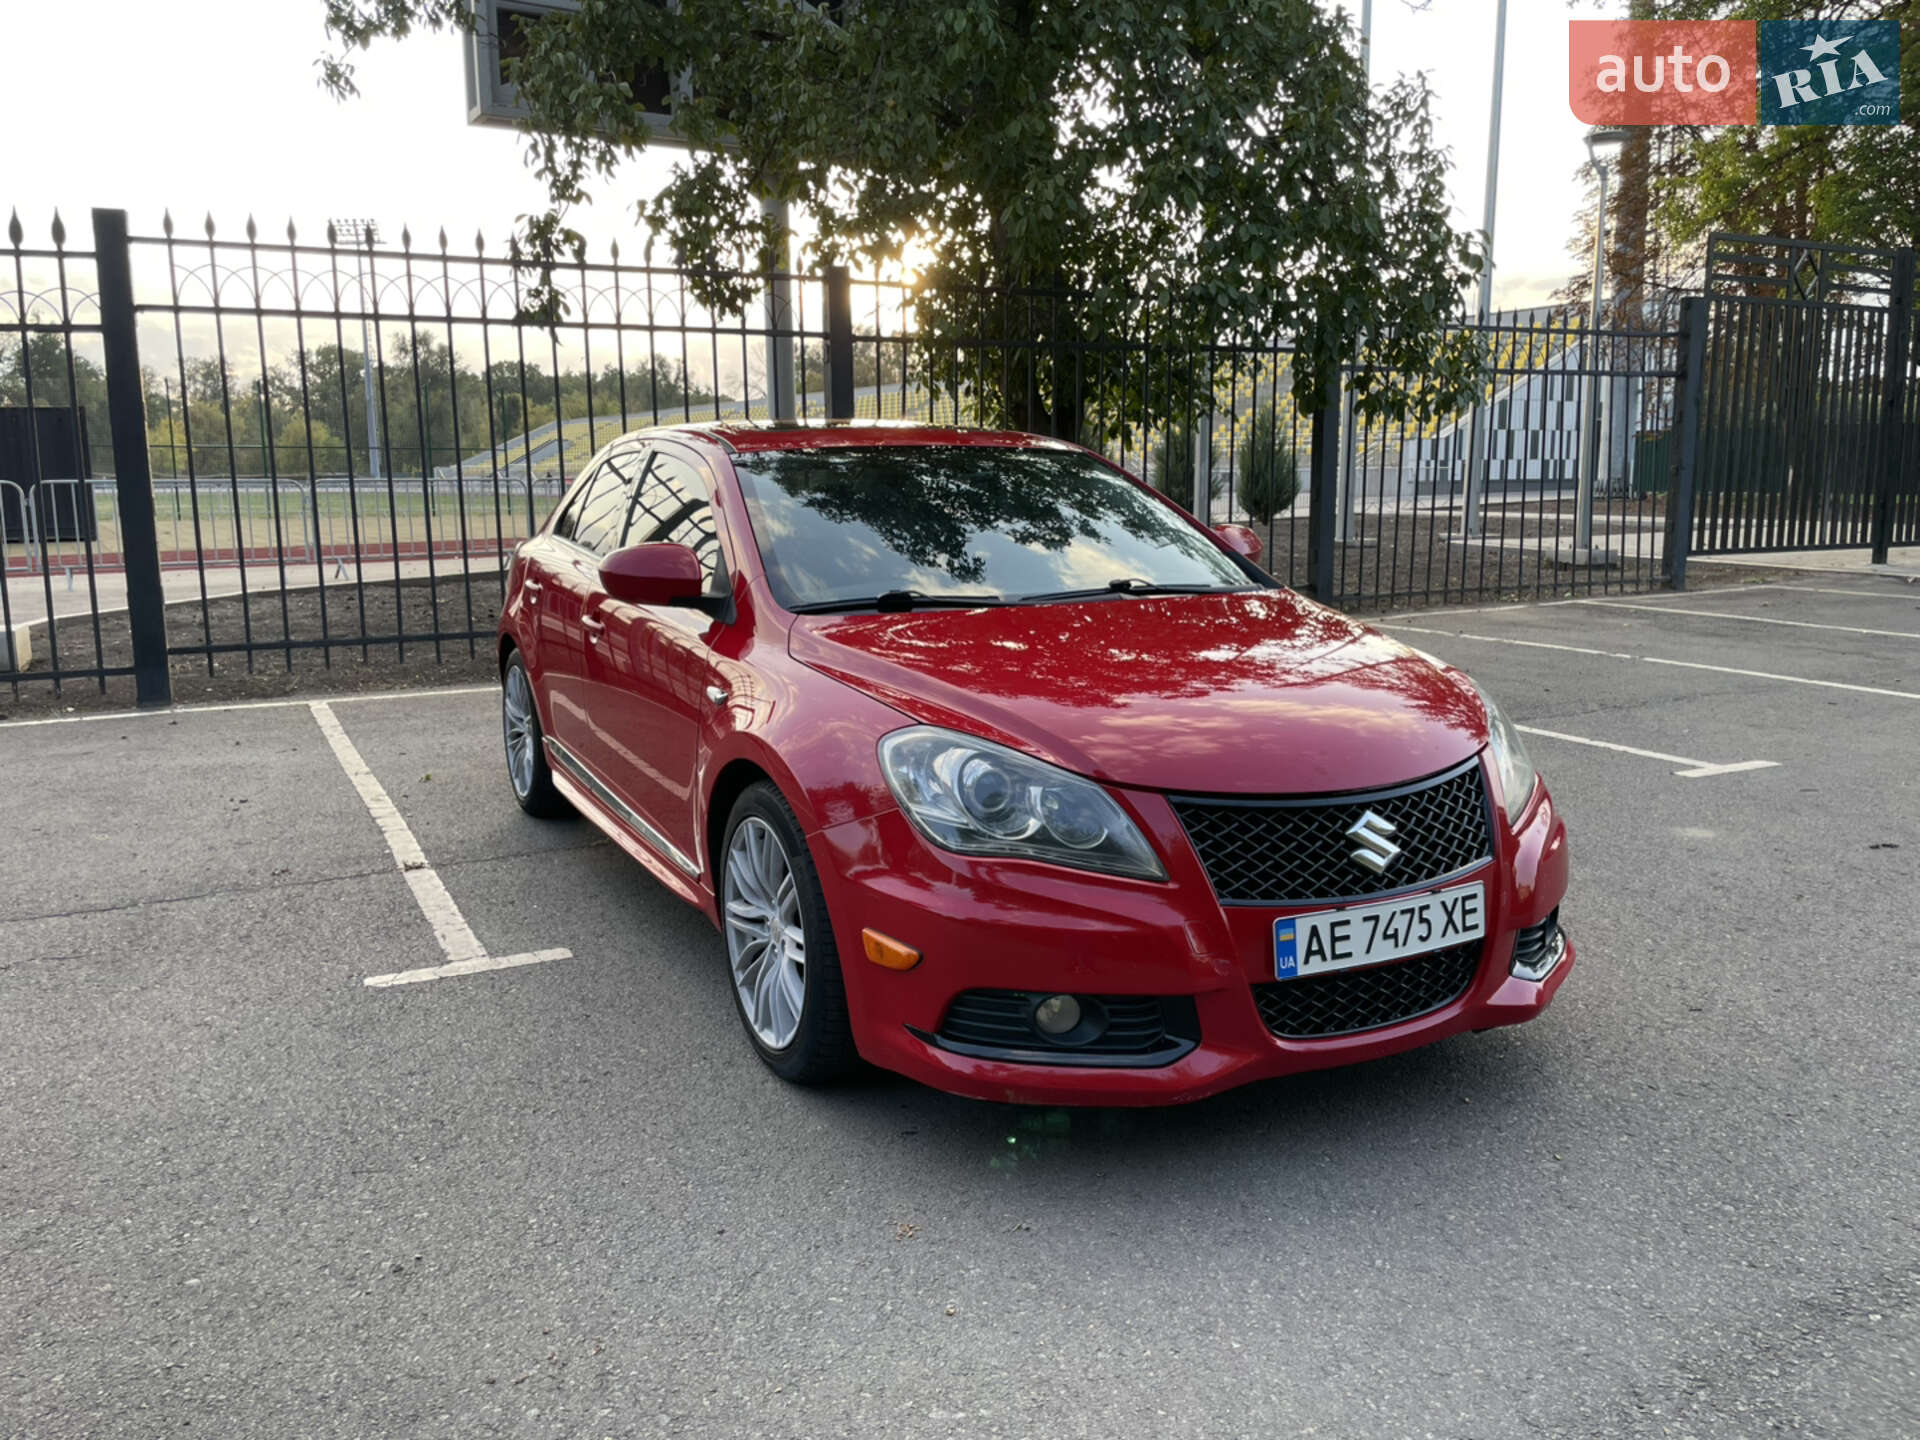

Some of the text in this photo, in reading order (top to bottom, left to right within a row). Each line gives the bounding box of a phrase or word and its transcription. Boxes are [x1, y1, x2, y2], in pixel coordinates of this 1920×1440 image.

[1303, 893, 1479, 965] AE 7475 XE
[1279, 955, 1296, 969] UA
